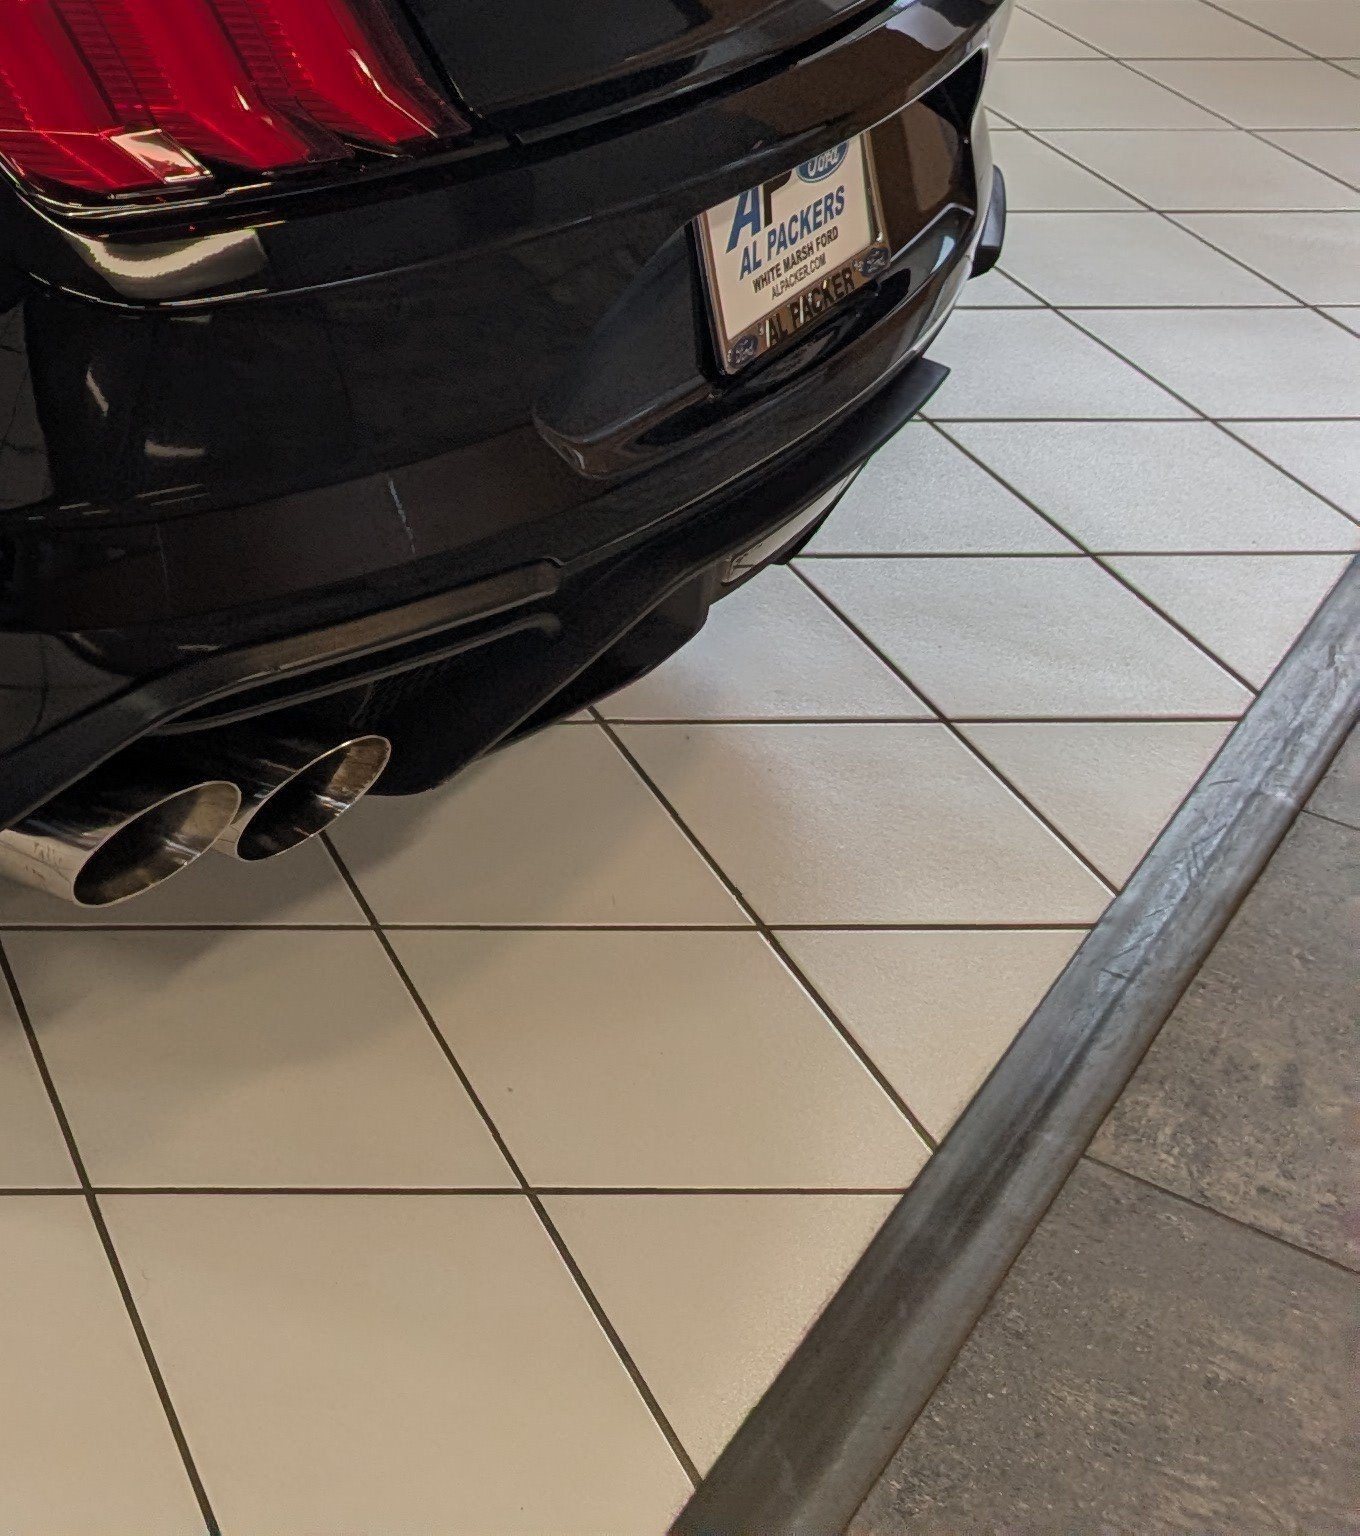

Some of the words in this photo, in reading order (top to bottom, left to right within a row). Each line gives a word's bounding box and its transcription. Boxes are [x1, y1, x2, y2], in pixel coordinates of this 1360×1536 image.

[739, 240, 763, 281] AL
[767, 185, 845, 262] PACKERS
[752, 262, 781, 294] WHITE
[782, 241, 815, 274] MARSH
[815, 225, 839, 252] FORD
